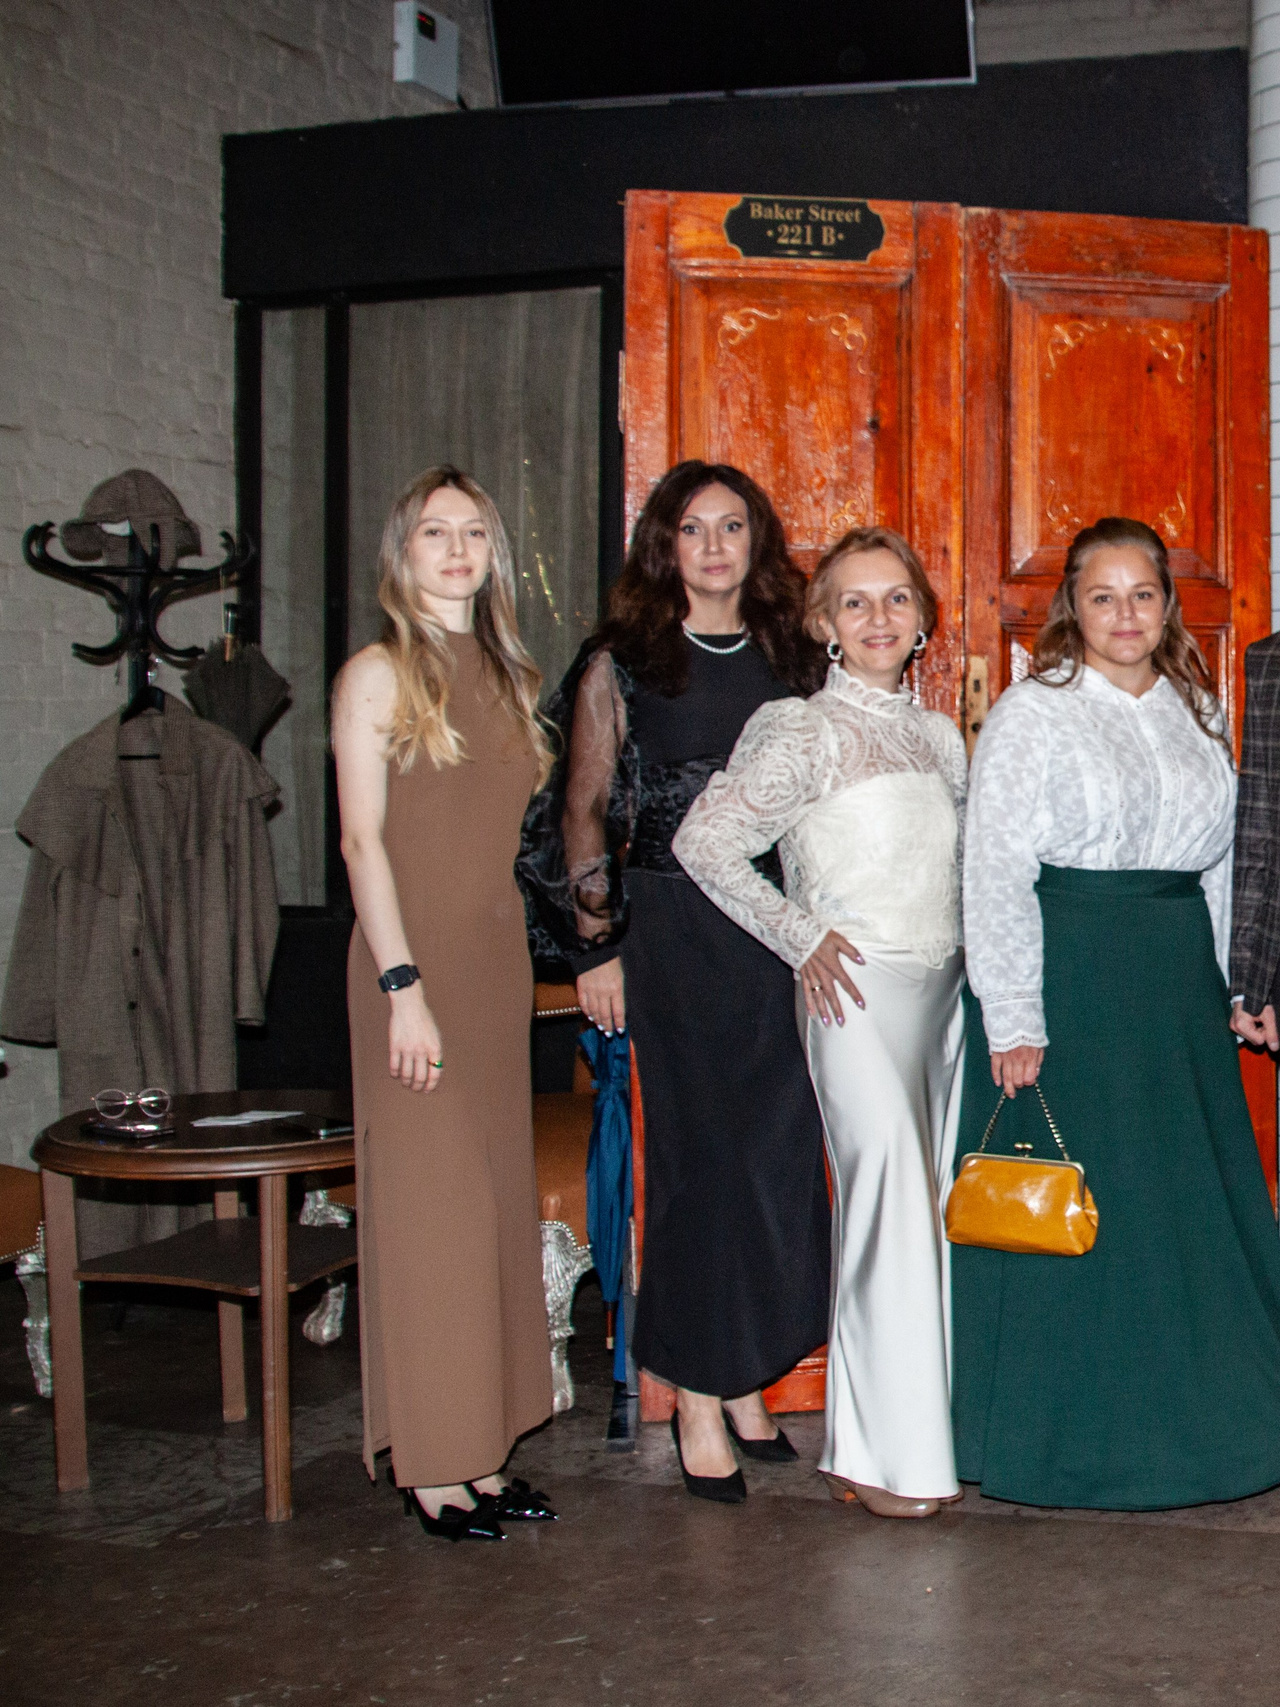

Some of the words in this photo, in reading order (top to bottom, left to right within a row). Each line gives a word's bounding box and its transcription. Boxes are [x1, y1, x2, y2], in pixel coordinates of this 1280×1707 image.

[750, 202, 804, 220] Baker
[808, 205, 861, 223] Street
[776, 225, 813, 246] 221
